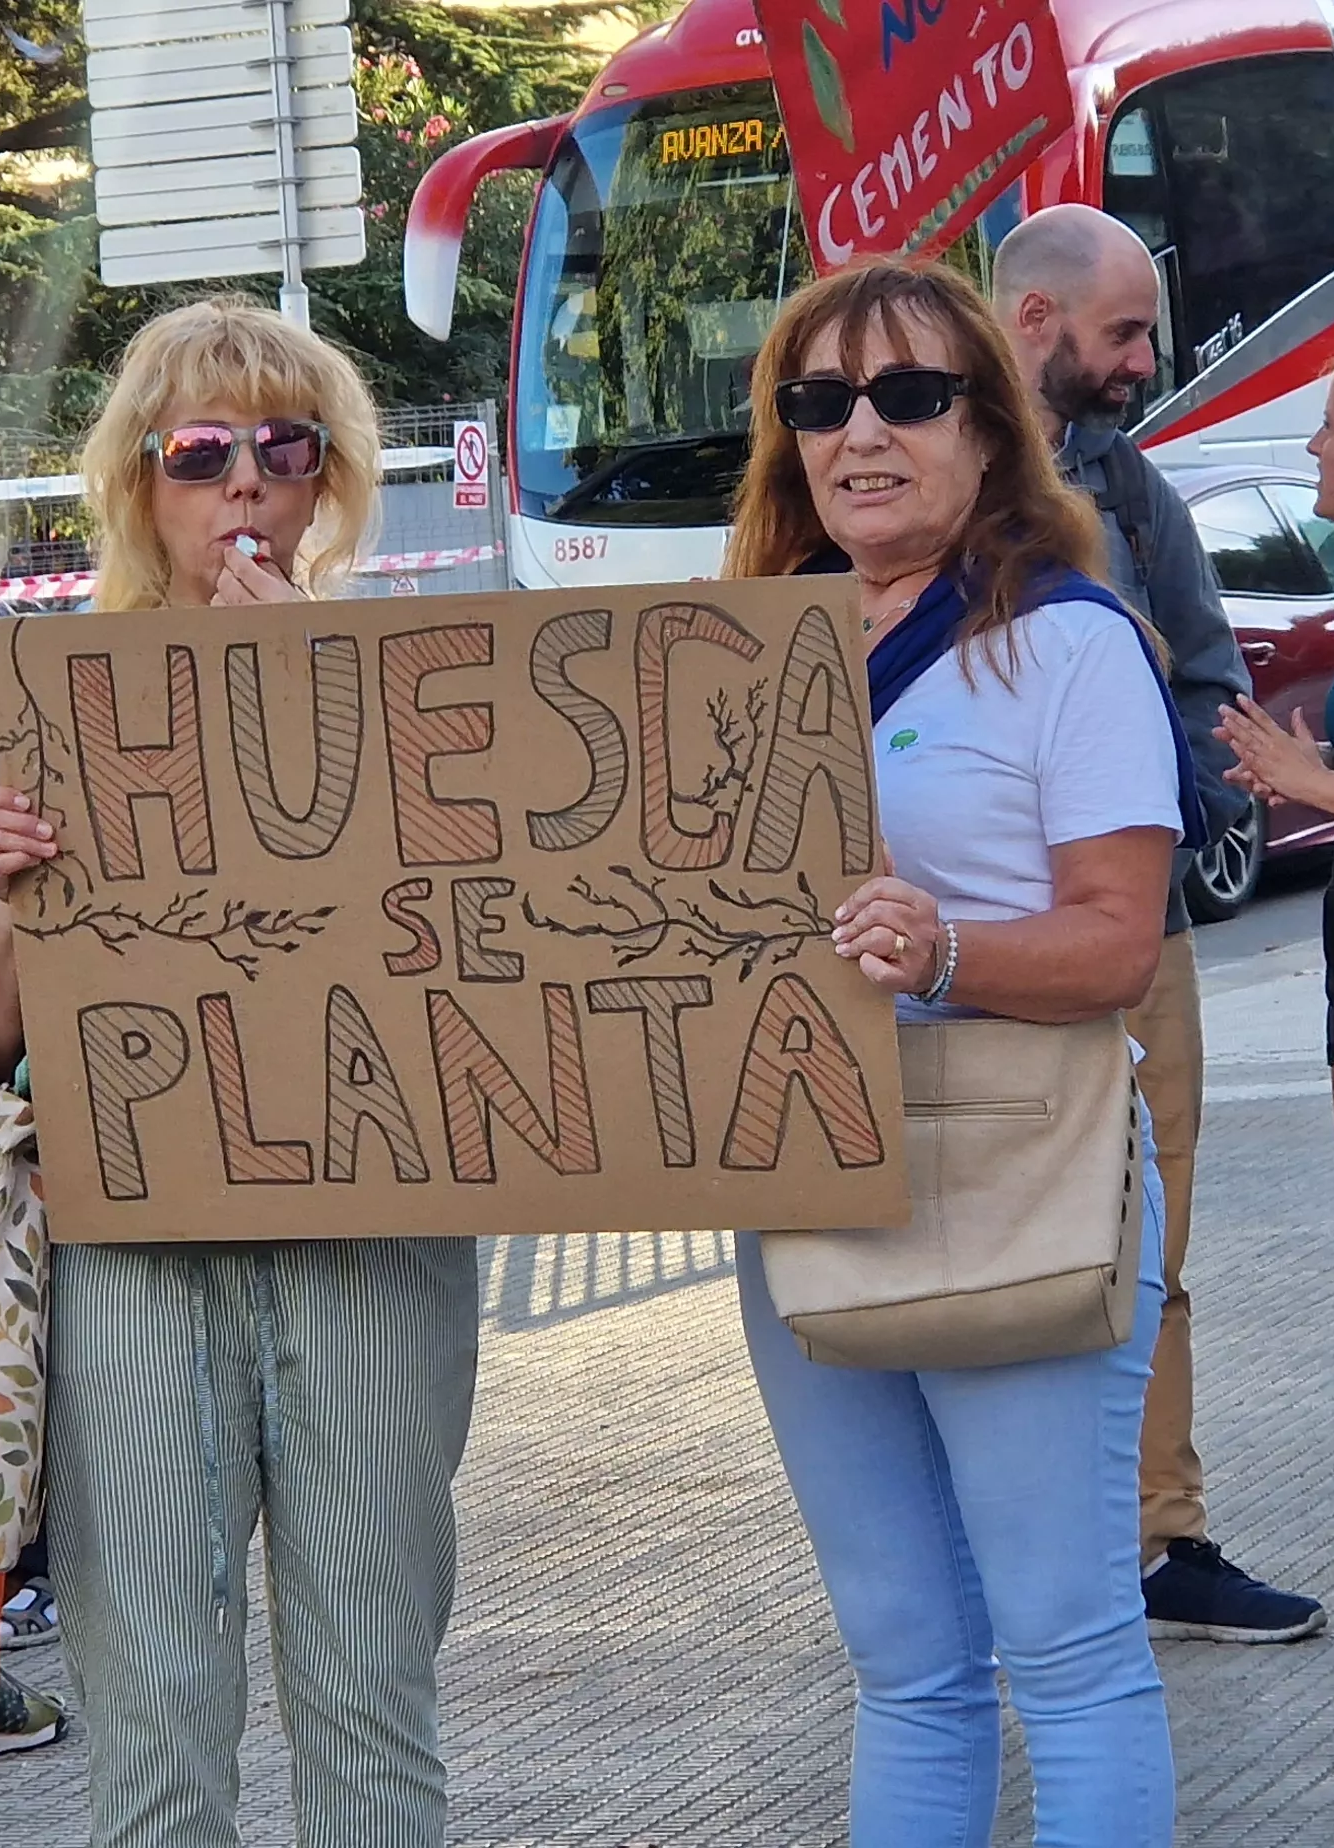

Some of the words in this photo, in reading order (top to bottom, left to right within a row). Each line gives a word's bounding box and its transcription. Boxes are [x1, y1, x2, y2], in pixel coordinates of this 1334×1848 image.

[662, 118, 763, 165] AVANZA
[817, 20, 1034, 267] CEMENTO
[554, 534, 609, 563] 8587
[67, 602, 873, 881] HUESCA
[382, 875, 525, 983] SE
[77, 972, 885, 1201] PLANTA
